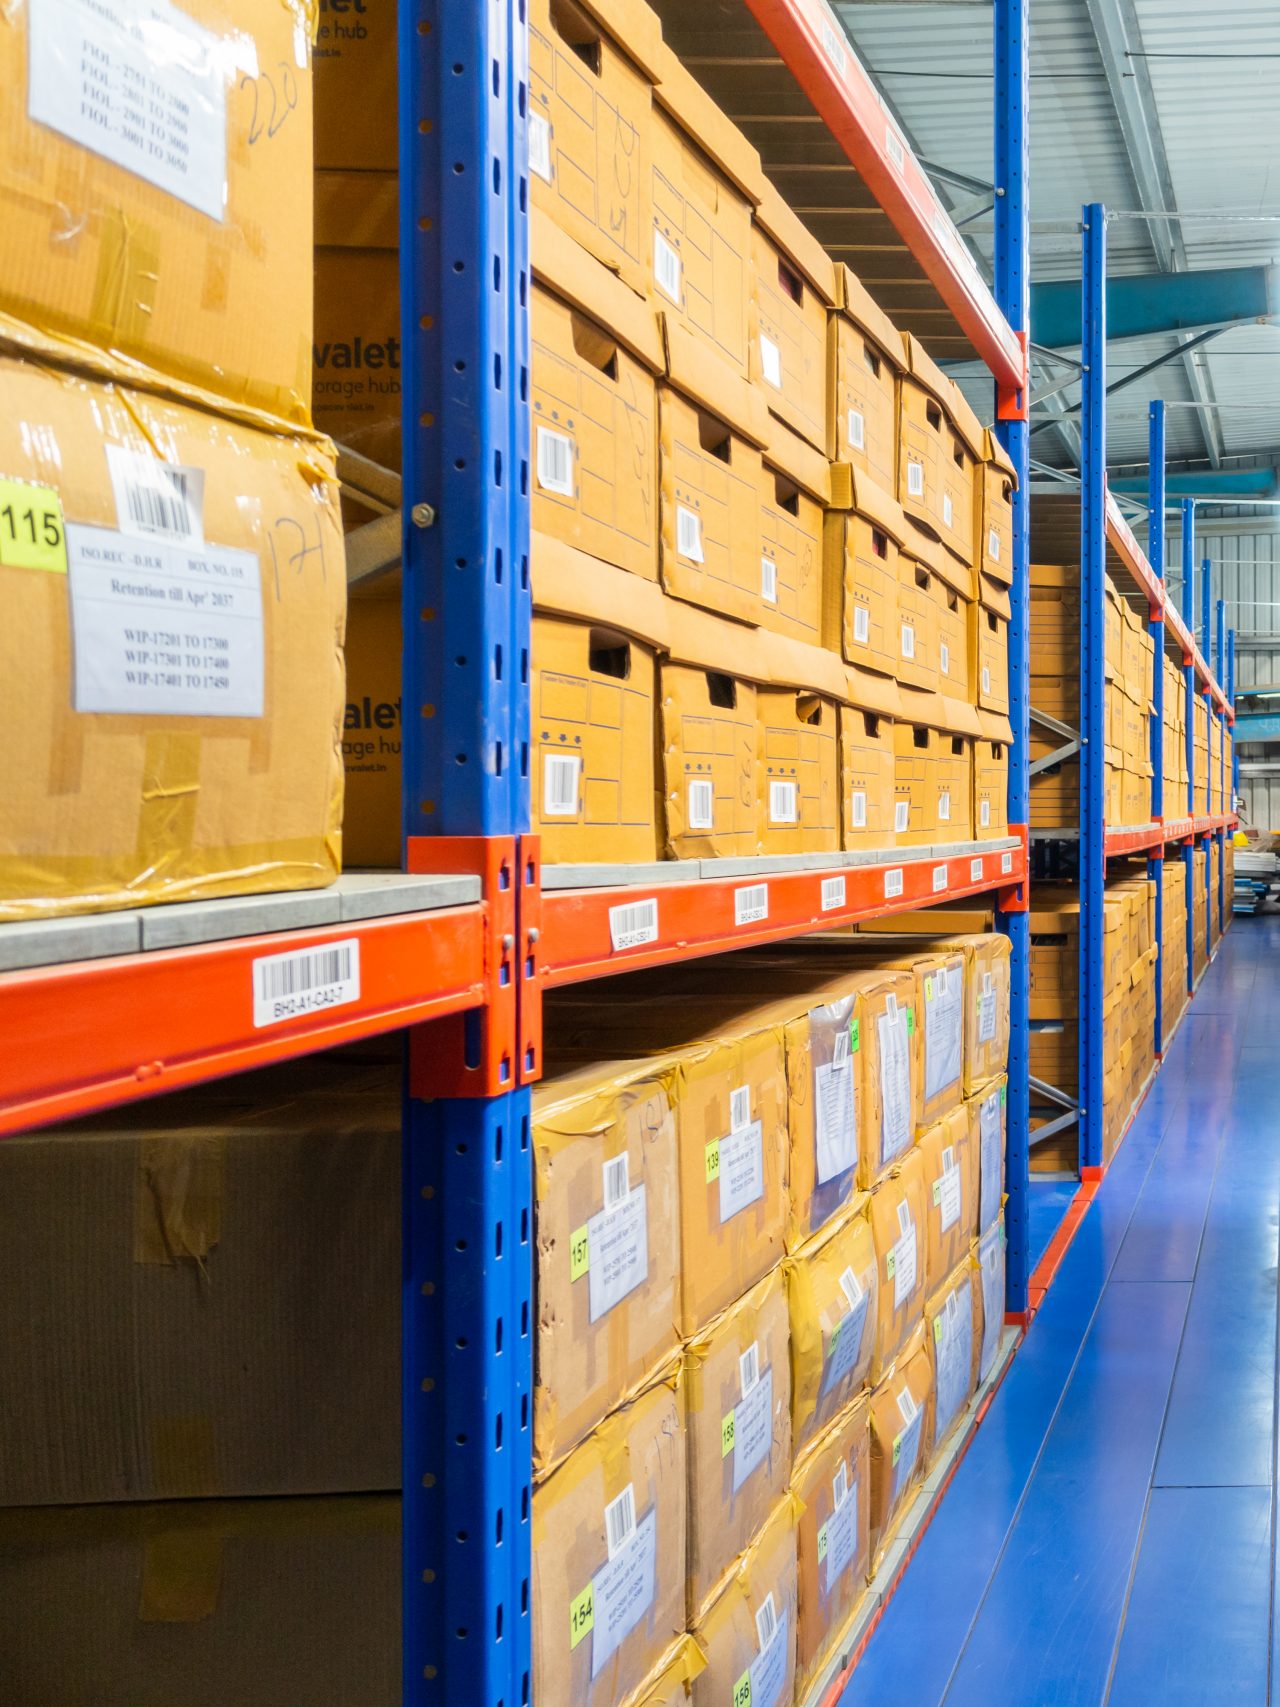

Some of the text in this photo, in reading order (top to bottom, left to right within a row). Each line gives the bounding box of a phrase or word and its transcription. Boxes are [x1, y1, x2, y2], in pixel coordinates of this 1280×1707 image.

[334, 20, 367, 39] hub
[314, 376, 402, 399] orage hub
[1, 504, 61, 547] 115
[110, 579, 167, 600] Retention
[169, 586, 184, 601] till
[185, 634, 200, 649] TO
[185, 653, 201, 669] TO
[185, 673, 201, 688] TO
[379, 735, 402, 754] hu
[707, 1151, 719, 1173] 139
[572, 1238, 587, 1267] 157
[572, 1596, 592, 1633] 154
[735, 1681, 750, 1707] 156
